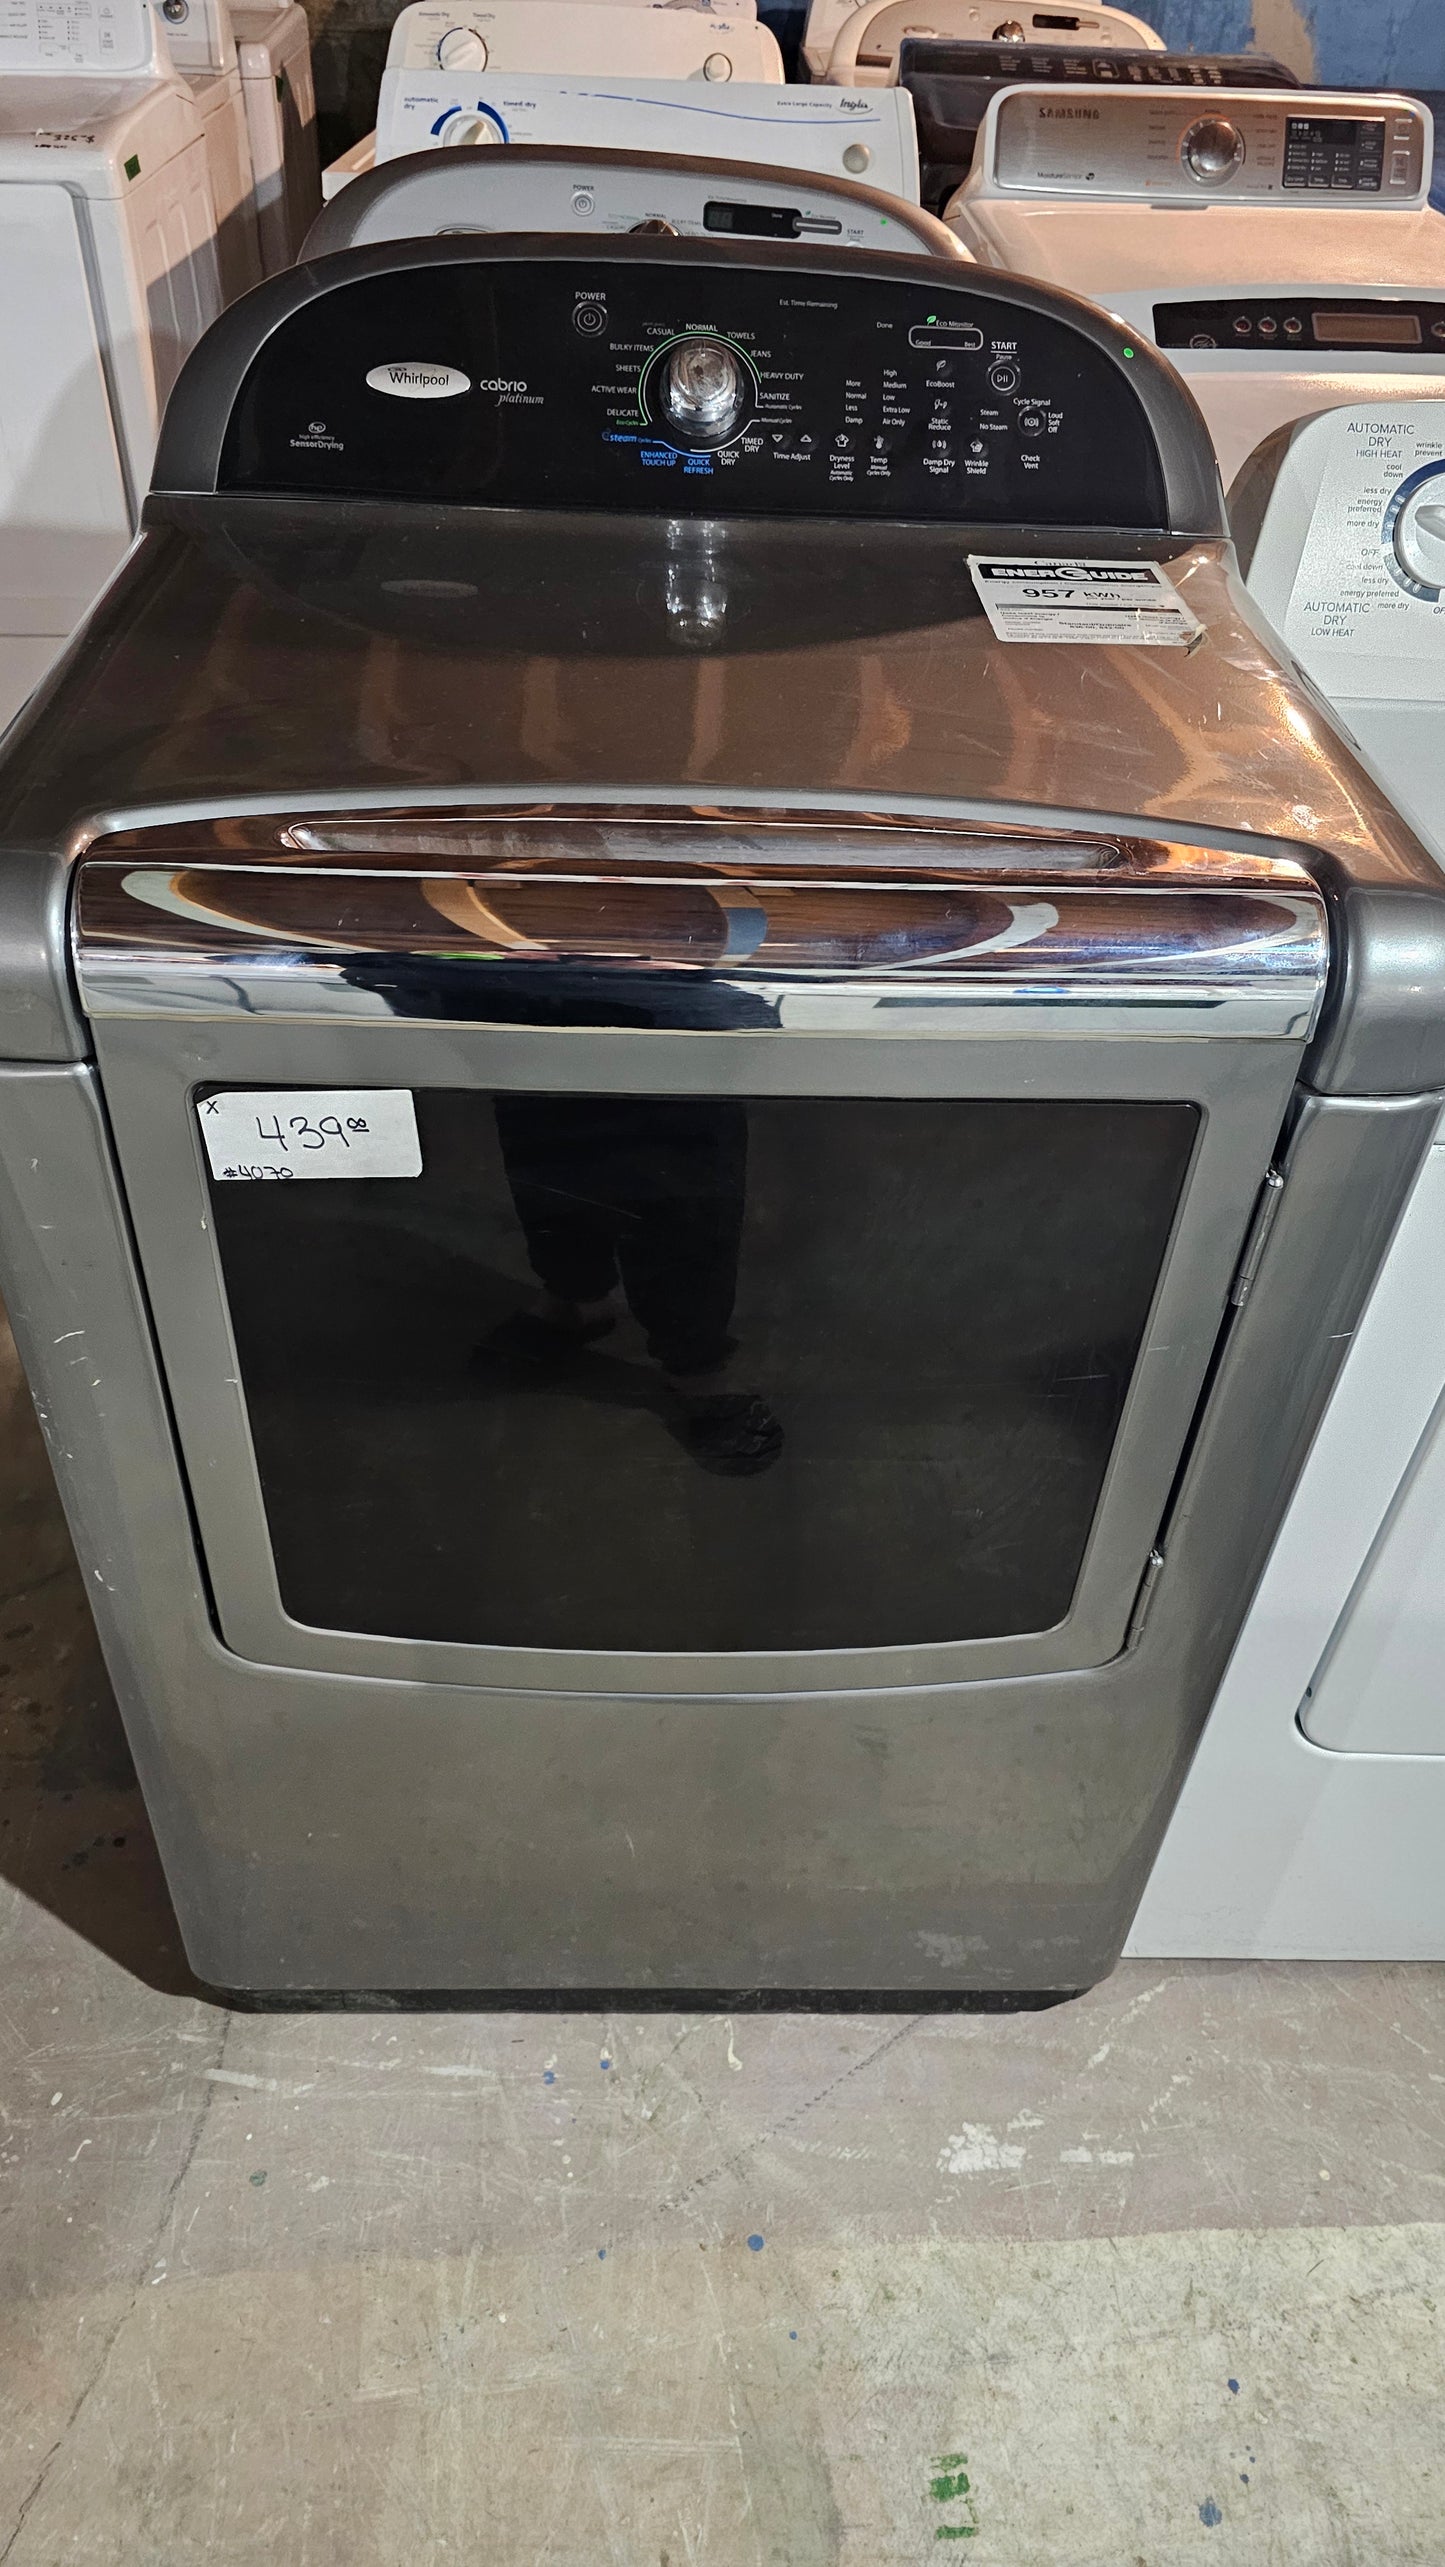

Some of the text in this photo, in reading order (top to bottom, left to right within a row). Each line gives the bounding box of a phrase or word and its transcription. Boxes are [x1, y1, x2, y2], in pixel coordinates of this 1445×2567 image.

[525, 101, 537, 109] dry
[1038, 107, 1100, 120] SAMSUNG
[575, 291, 606, 300] POWER
[791, 299, 806, 307] Time
[806, 300, 838, 309] Remaining
[685, 323, 718, 332] NORMAL
[876, 321, 893, 329] Done
[646, 327, 676, 335] CASUAL
[727, 331, 756, 340] TOWELS
[609, 342, 654, 352] BULKY ITEMS
[991, 341, 1018, 350] START
[750, 350, 772, 358] JEANS
[615, 364, 641, 373] SHEETS
[760, 371, 805, 381] HEAVY DUTY
[883, 369, 898, 378] High
[389, 371, 450, 388] Whirlpool
[926, 380, 955, 388] EcoBoost
[480, 378, 528, 393] cabrio
[591, 385, 637, 394] ACTIVE WEAR
[883, 381, 907, 389] Medium
[494, 393, 545, 407] platinum
[760, 393, 791, 401] SANITIZE
[845, 392, 867, 400] Normal
[1013, 398, 1051, 406] Cycle Signal
[606, 408, 639, 417] DELICATE
[845, 404, 858, 412] Less
[882, 405, 911, 414] Extra Low
[844, 416, 863, 426] Damp
[891, 418, 906, 427] Only
[1048, 418, 1061, 426] Soft
[1347, 422, 1415, 435] AUTOMATIC
[609, 433, 638, 443] steam
[741, 436, 764, 446] TIMED
[1368, 437, 1392, 447] DRY
[290, 439, 344, 451] SensorDrying
[744, 444, 760, 453] DRY
[641, 450, 678, 459] ENHANCED
[717, 450, 740, 459] QUICK
[773, 452, 811, 462] Time Adjust
[1356, 449, 1403, 459] HIGH HEAT
[1414, 449, 1443, 457] prevent
[688, 458, 710, 467] QUICK
[721, 458, 736, 466] DRY
[829, 454, 855, 463] Dryness
[870, 456, 888, 464] Temp
[923, 458, 955, 467] Damp Dry
[1020, 454, 1041, 462] Check
[642, 459, 677, 467] TOUCH UP
[833, 462, 851, 470] Level
[964, 459, 989, 467] Wrinkle
[1023, 462, 1039, 470] Vent
[683, 467, 714, 475] REFRESH
[929, 466, 949, 475] Signal
[966, 467, 987, 475] Shield
[1357, 499, 1383, 507] energy
[1367, 520, 1380, 529] dry
[1361, 548, 1380, 556] OFF
[991, 567, 1149, 581] ENERGUIDE
[1362, 576, 1389, 585] less dry
[1022, 588, 1121, 599] 957 kWh
[1340, 590, 1400, 598] energy preferred
[1303, 602, 1371, 614] AUTOMATIC
[1397, 602, 1410, 611] dry
[1323, 614, 1347, 625] DRY
[1311, 628, 1355, 637] LOW HEAT
[223, 1165, 294, 1180] #4070
